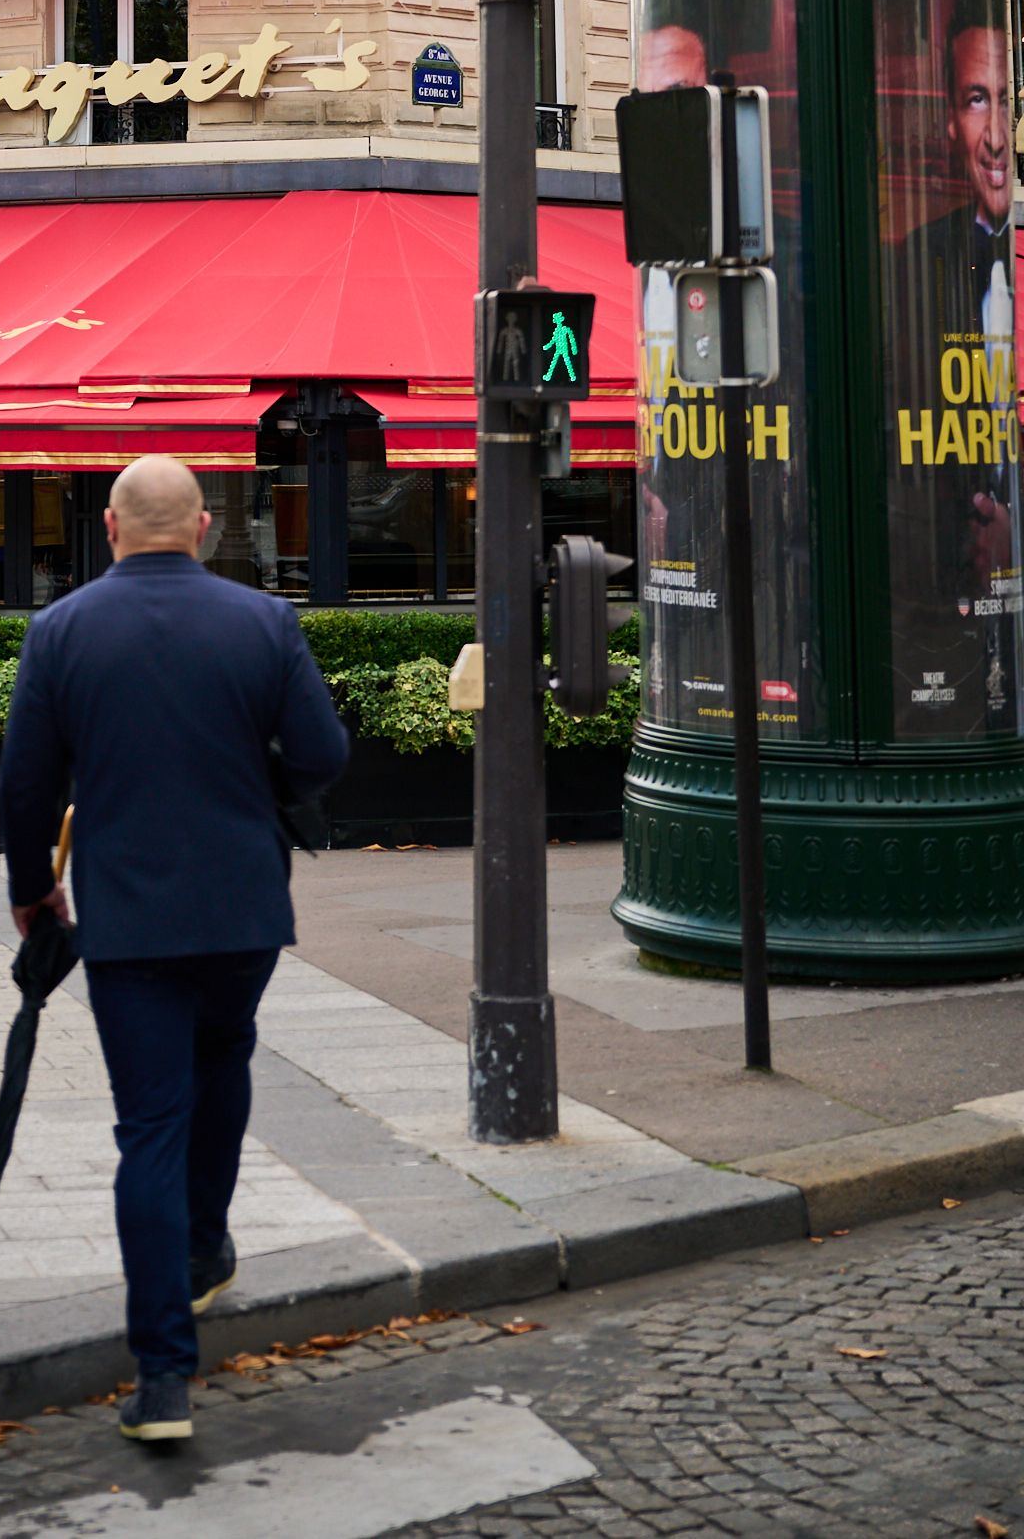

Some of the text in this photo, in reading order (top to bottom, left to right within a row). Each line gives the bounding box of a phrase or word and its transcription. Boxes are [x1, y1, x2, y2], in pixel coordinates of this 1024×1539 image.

[423, 73, 453, 85] AVENUE
[418, 87, 457, 99] GEORGE V
[943, 333, 962, 342] UNE
[897, 409, 1019, 465] HARFO
